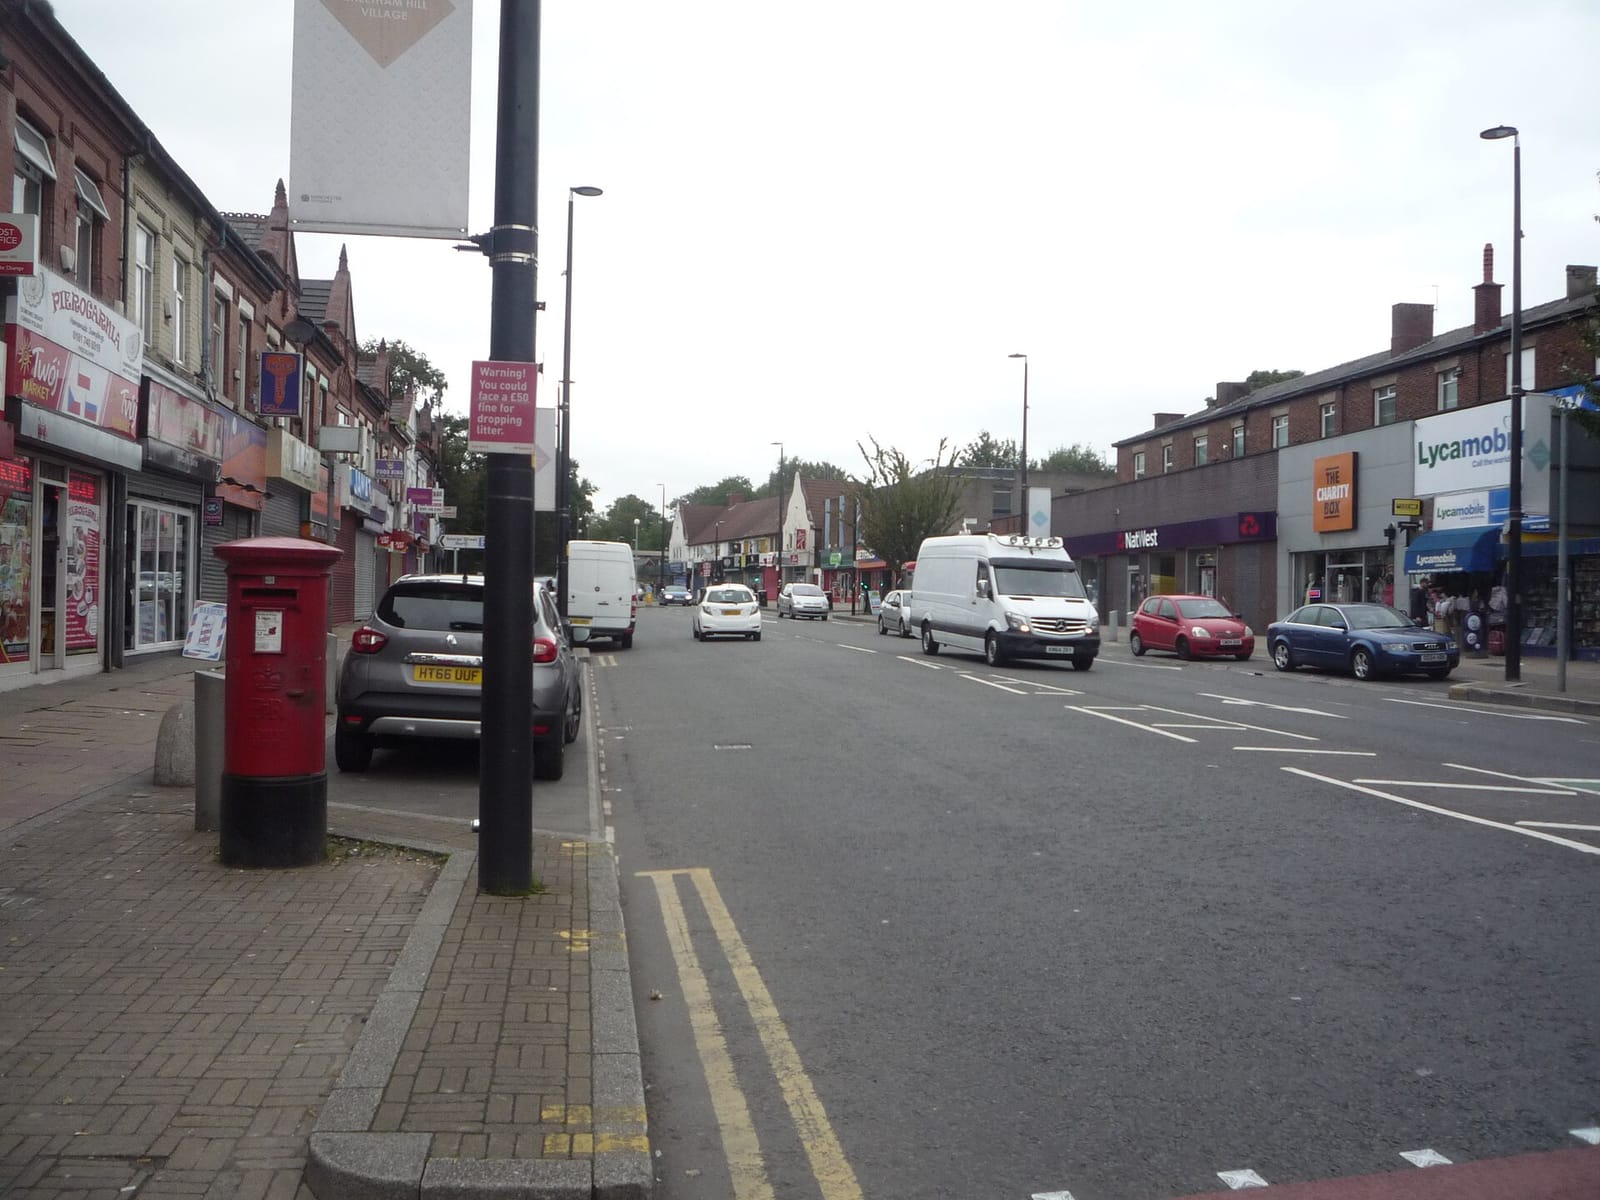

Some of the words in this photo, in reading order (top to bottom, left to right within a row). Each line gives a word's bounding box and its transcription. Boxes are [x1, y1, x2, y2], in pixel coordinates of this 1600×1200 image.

[406, 0, 426, 9] HILL
[360, 8, 408, 20] VILLAGE
[32, 346, 60, 397] Twój
[480, 367, 526, 379] Warning!
[22, 378, 49, 400] MARKET
[479, 380, 497, 390] You
[500, 382, 527, 391] could
[478, 391, 499, 401] face
[501, 394, 508, 402] a
[511, 392, 529, 402] £50
[478, 402, 497, 412] fine
[500, 404, 515, 413] for
[477, 414, 523, 427] dropping
[476, 425, 504, 436] litter.
[1418, 427, 1524, 468] Lycamobi
[1326, 470, 1340, 485] THE
[1316, 484, 1350, 502] CHARITY
[1324, 501, 1340, 515] BOX
[1436, 503, 1486, 520] Lycamobile
[1125, 528, 1158, 550] NatWest
[1416, 551, 1456, 566] Lycamobile
[419, 667, 451, 681] HT66
[455, 667, 479, 682] UUF
